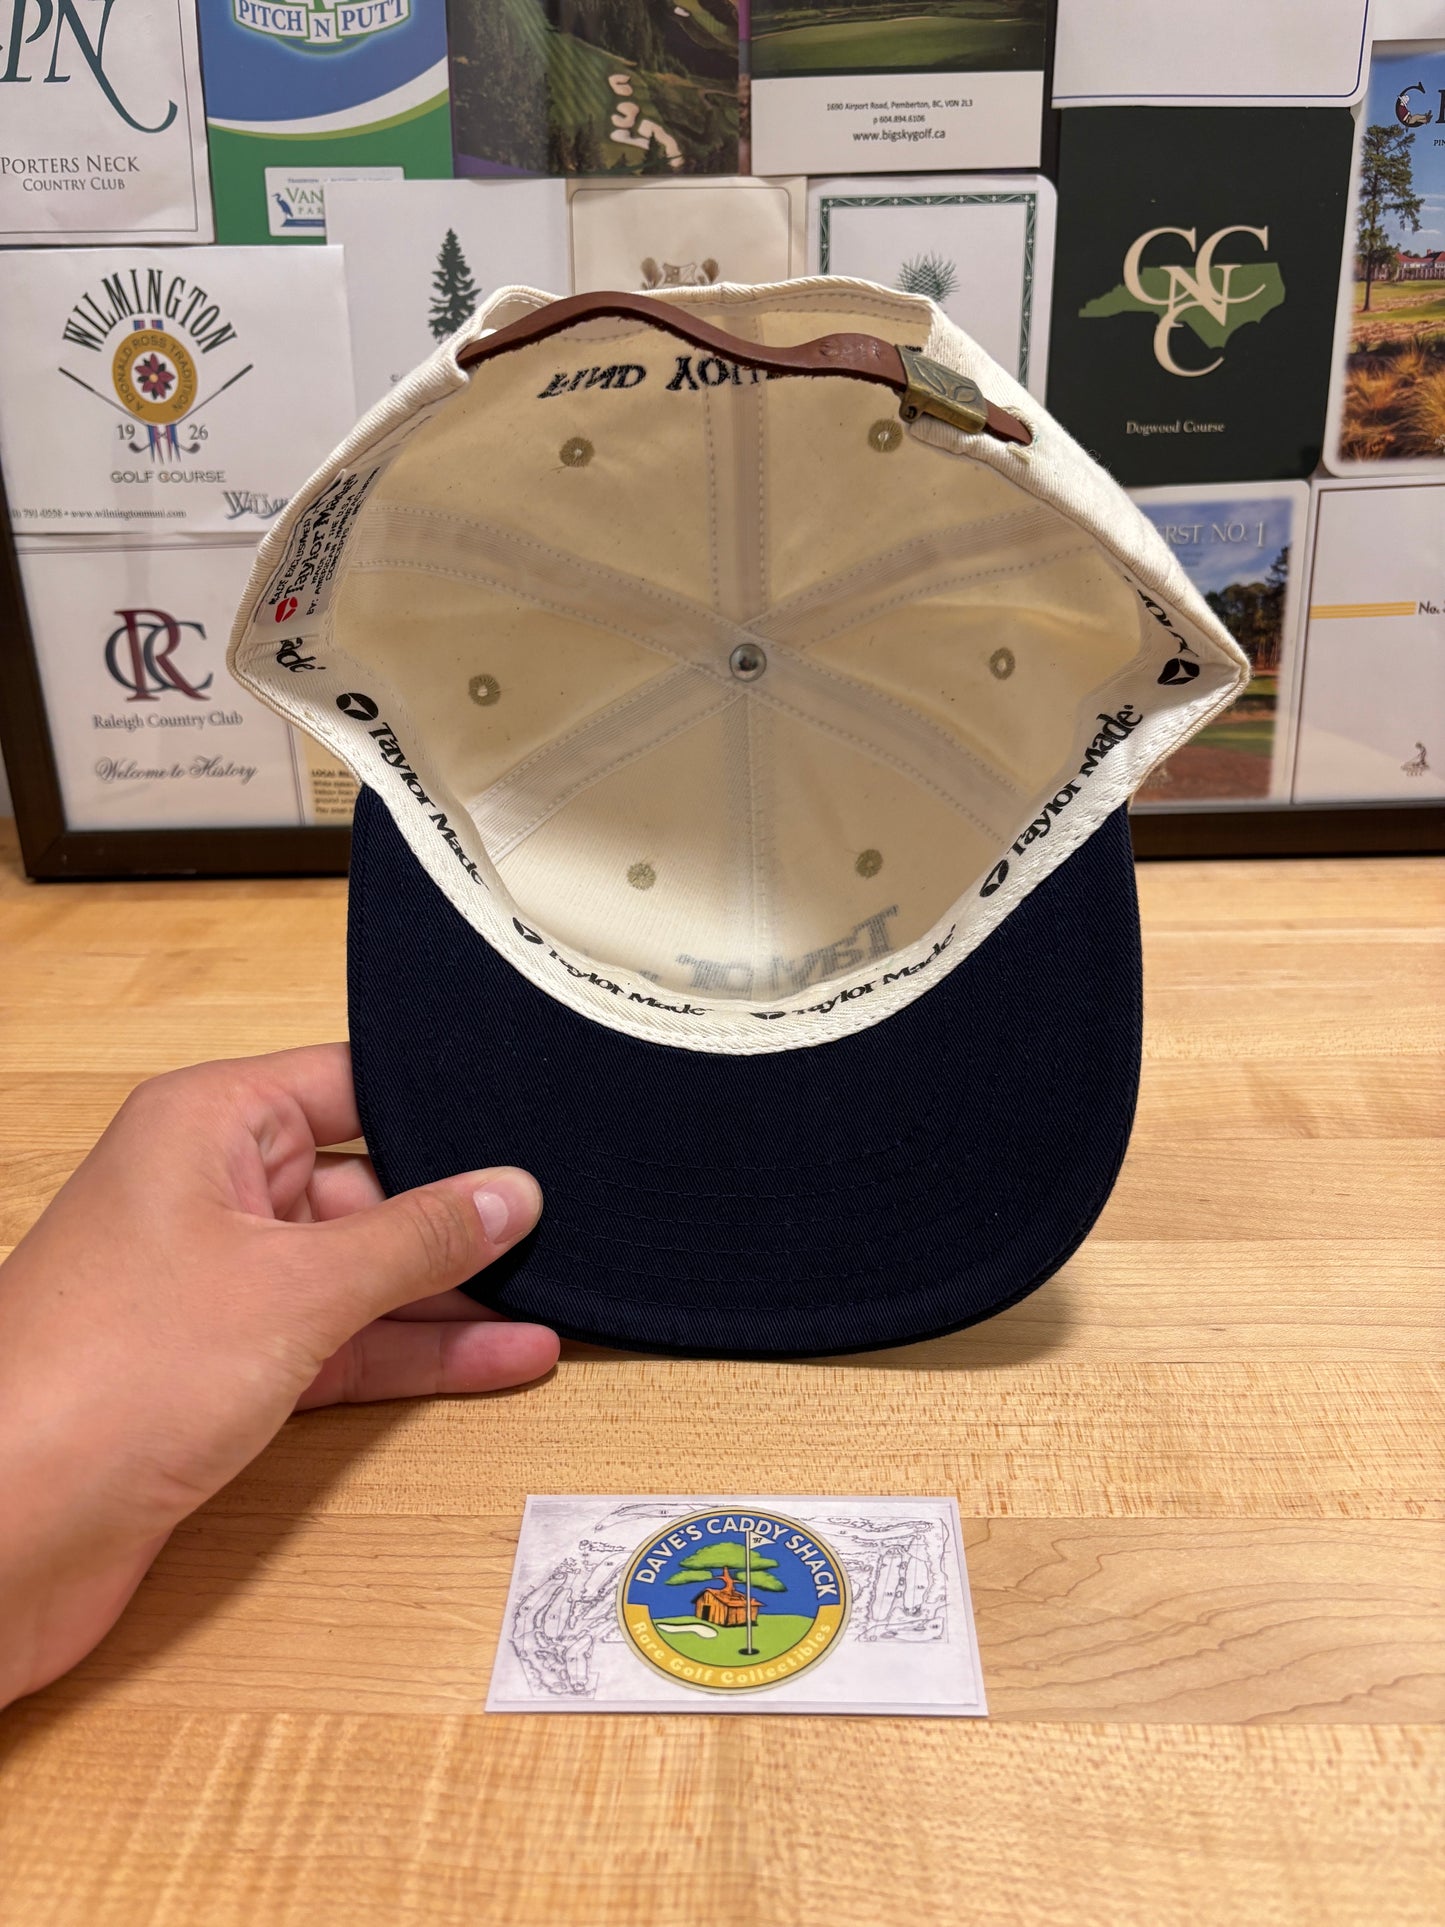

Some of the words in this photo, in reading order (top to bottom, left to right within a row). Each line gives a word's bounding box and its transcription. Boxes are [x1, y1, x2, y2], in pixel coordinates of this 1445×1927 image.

[238, 0, 303, 32] PITCH
[314, 18, 330, 37] N
[340, 0, 404, 32] PUTT
[845, 102, 869, 112] Airport
[891, 100, 930, 110] Pemberton,
[853, 128, 946, 142] www.bigskygolf.ca
[0, 156, 80, 174] PORTERS
[86, 155, 141, 173] NECK
[22, 178, 86, 192] COUNTRY
[90, 177, 126, 191] CLUB
[62, 268, 238, 354] WILMINGTON
[131, 335, 168, 348] ROSS
[118, 425, 135, 441] 19
[189, 424, 208, 441] 26
[1126, 419, 1180, 436] Dogwood
[1183, 419, 1225, 433] Course
[110, 470, 154, 483] GOLF
[158, 470, 227, 483] COURSE
[1163, 524, 1204, 545] RST
[284, 531, 325, 599] Taylor
[93, 713, 144, 731] Raleigh
[149, 713, 204, 731] Country
[209, 710, 243, 726] Club
[96, 756, 165, 781] Welcome
[169, 762, 184, 778] to
[189, 755, 257, 784] History
[1007, 779, 1082, 856] Taylor
[1079, 708, 1144, 777] Made
[368, 721, 436, 808] Taylor
[429, 812, 483, 885] Made
[635, 1525, 703, 1584] DAVE'S
[706, 1516, 789, 1541] CADDY
[785, 1534, 838, 1599] SHACK
[632, 1621, 665, 1660] Rare
[669, 1657, 714, 1683] Golf
[720, 1623, 832, 1685] Collectibles
